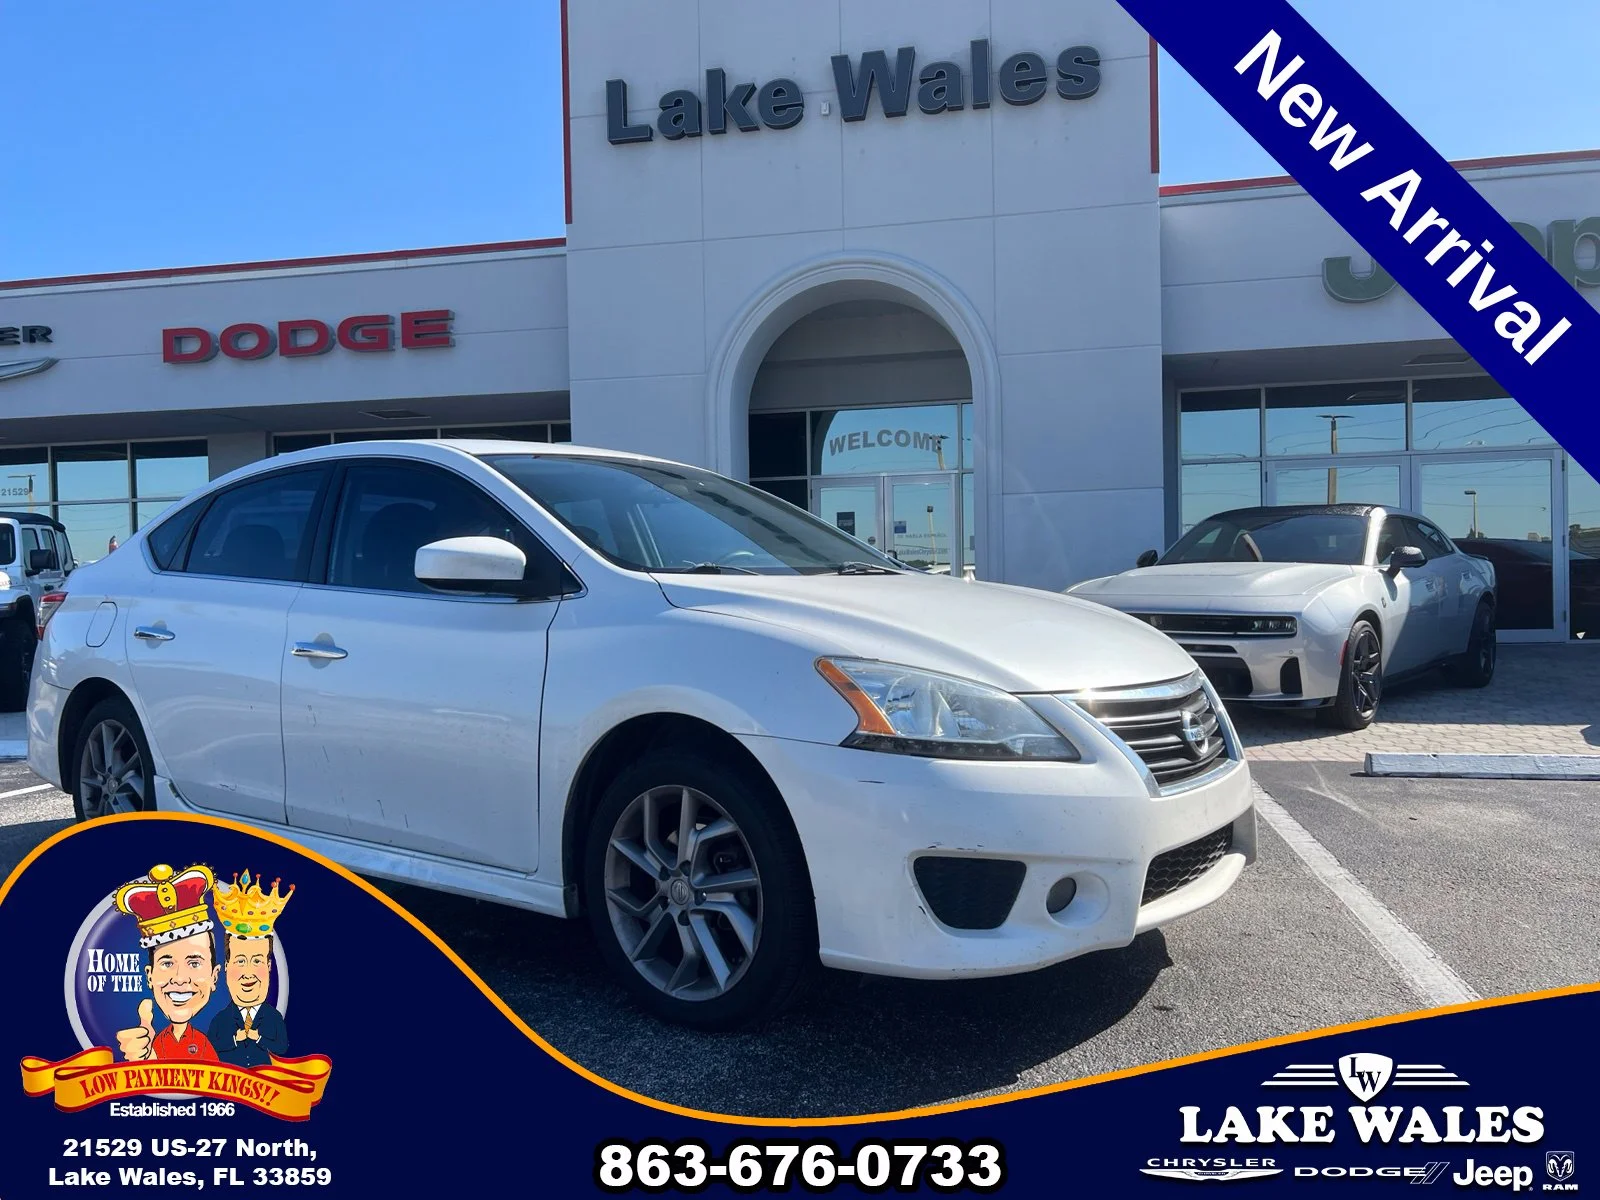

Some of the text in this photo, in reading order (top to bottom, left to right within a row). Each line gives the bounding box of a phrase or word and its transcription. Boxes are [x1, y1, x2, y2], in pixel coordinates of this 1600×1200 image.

[605, 38, 1103, 145] Lake Wales
[162, 309, 456, 364] DODGE
[829, 429, 942, 457] WELCOME
[1, 487, 30, 496] 21529
